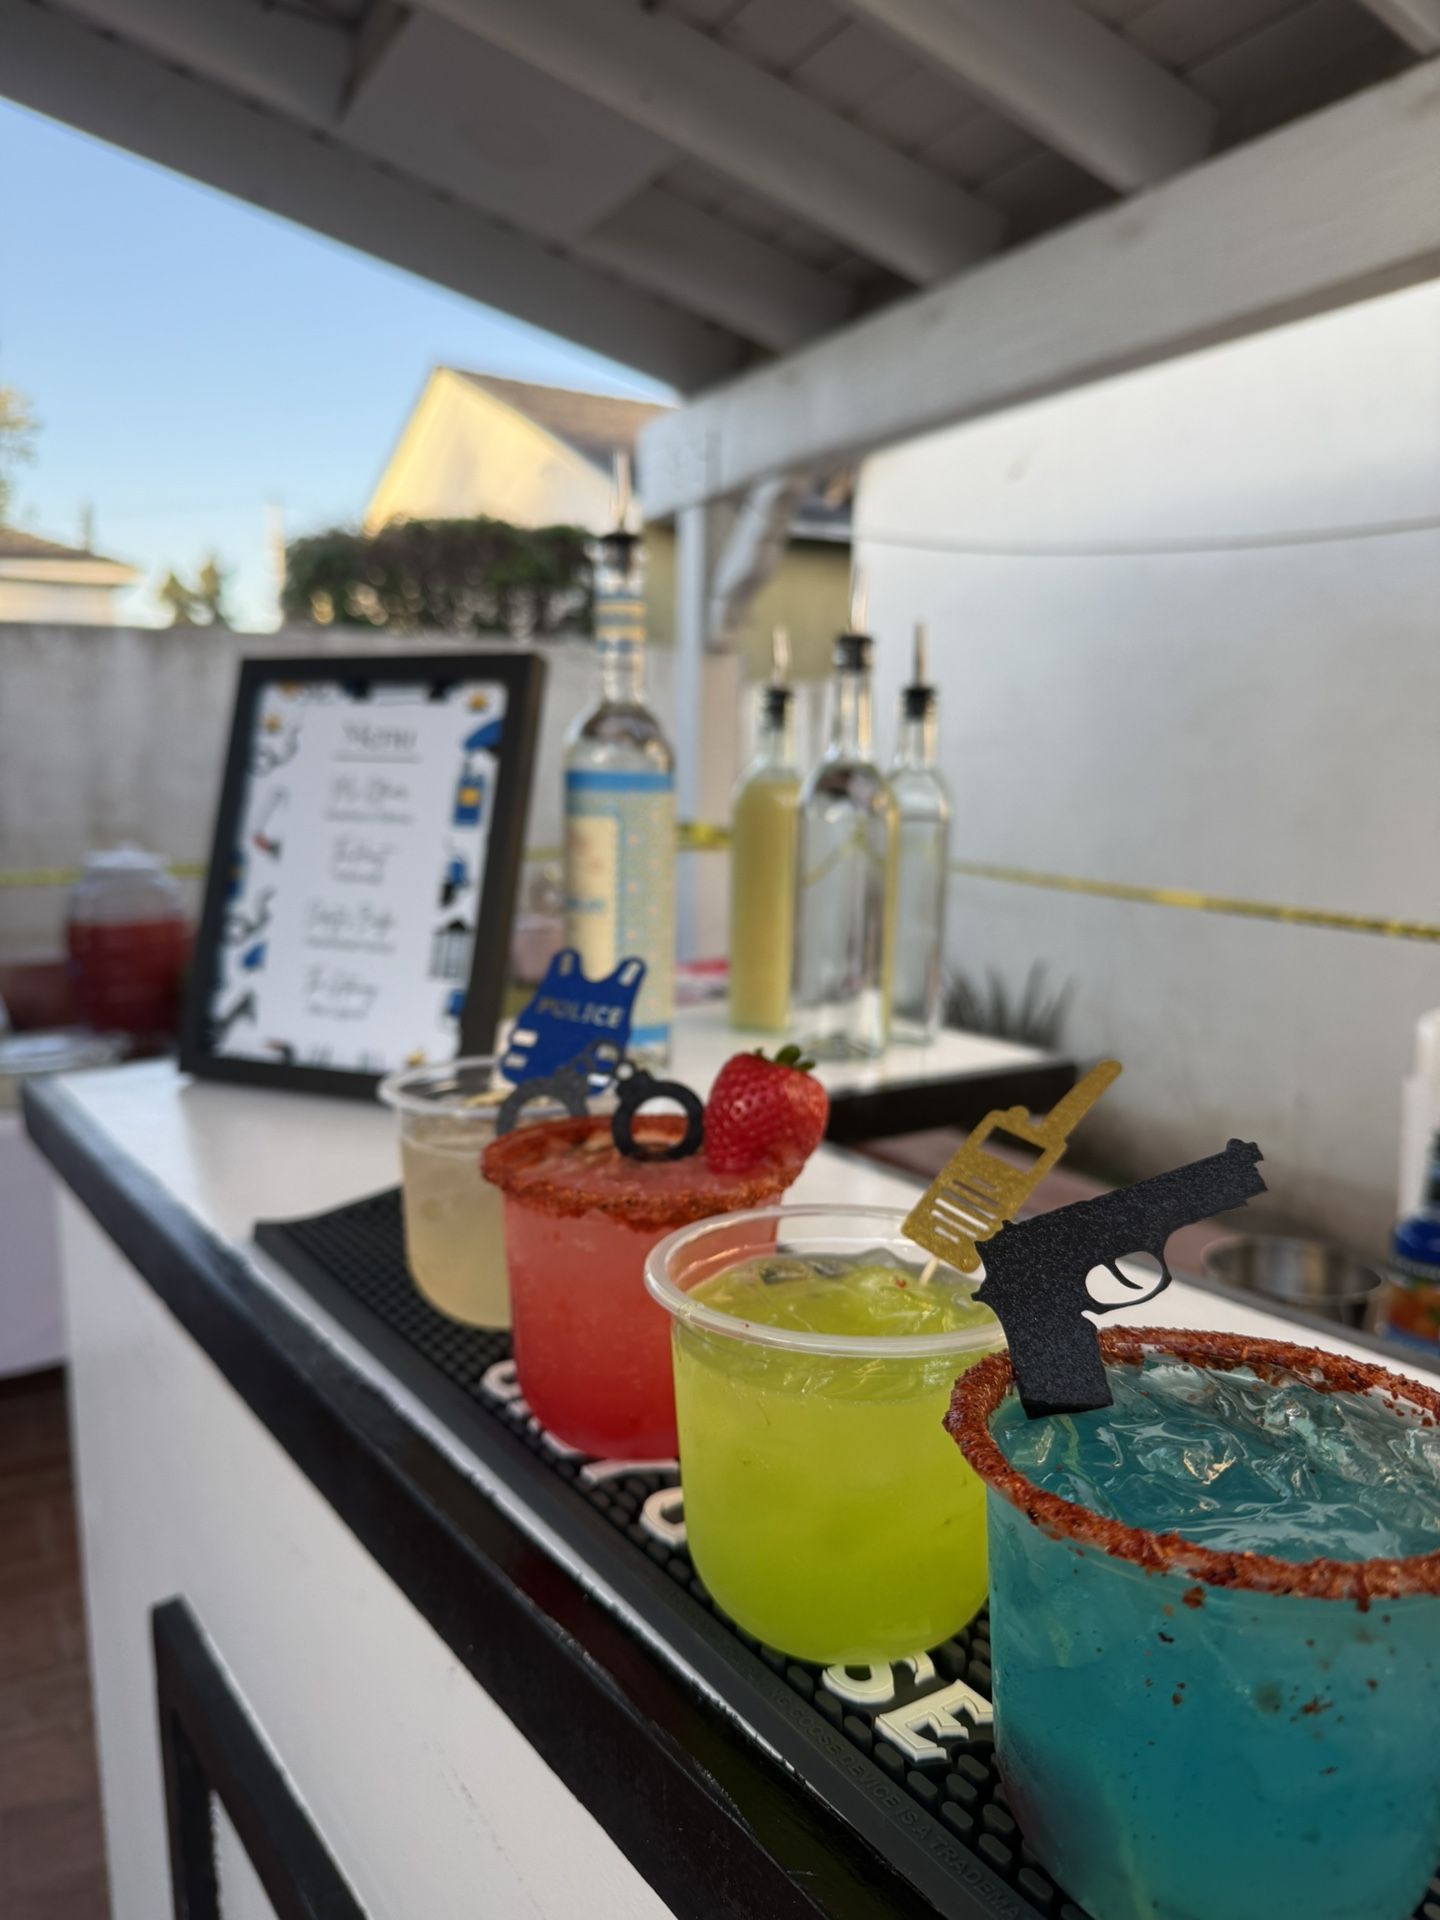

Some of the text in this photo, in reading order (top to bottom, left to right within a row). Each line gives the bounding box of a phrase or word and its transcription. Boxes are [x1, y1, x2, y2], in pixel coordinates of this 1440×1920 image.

[537, 996, 624, 1029] POLICE
[836, 1755, 901, 1808] DEVICE
[896, 1805, 919, 1825] IS
[912, 1826, 932, 1841] A
